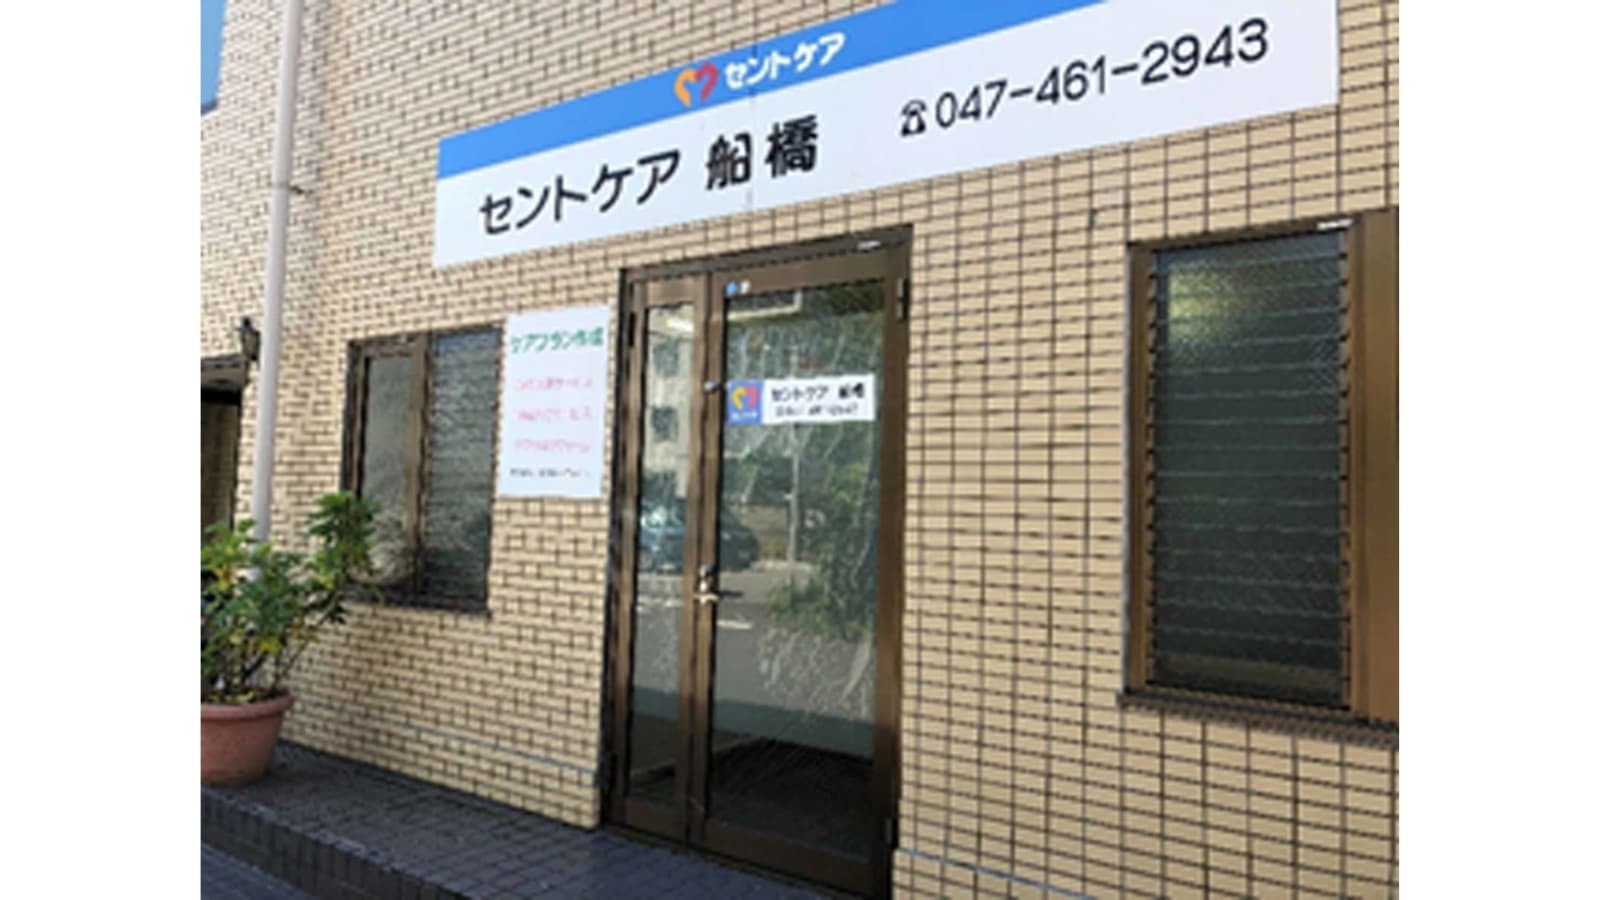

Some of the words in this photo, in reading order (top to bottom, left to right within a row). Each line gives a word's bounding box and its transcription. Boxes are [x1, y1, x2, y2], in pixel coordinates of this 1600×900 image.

[724, 32, 846, 89] セントケア
[935, 17, 1269, 129] 047-461-2943
[480, 149, 680, 236] セントケア
[705, 114, 818, 190] 船橋
